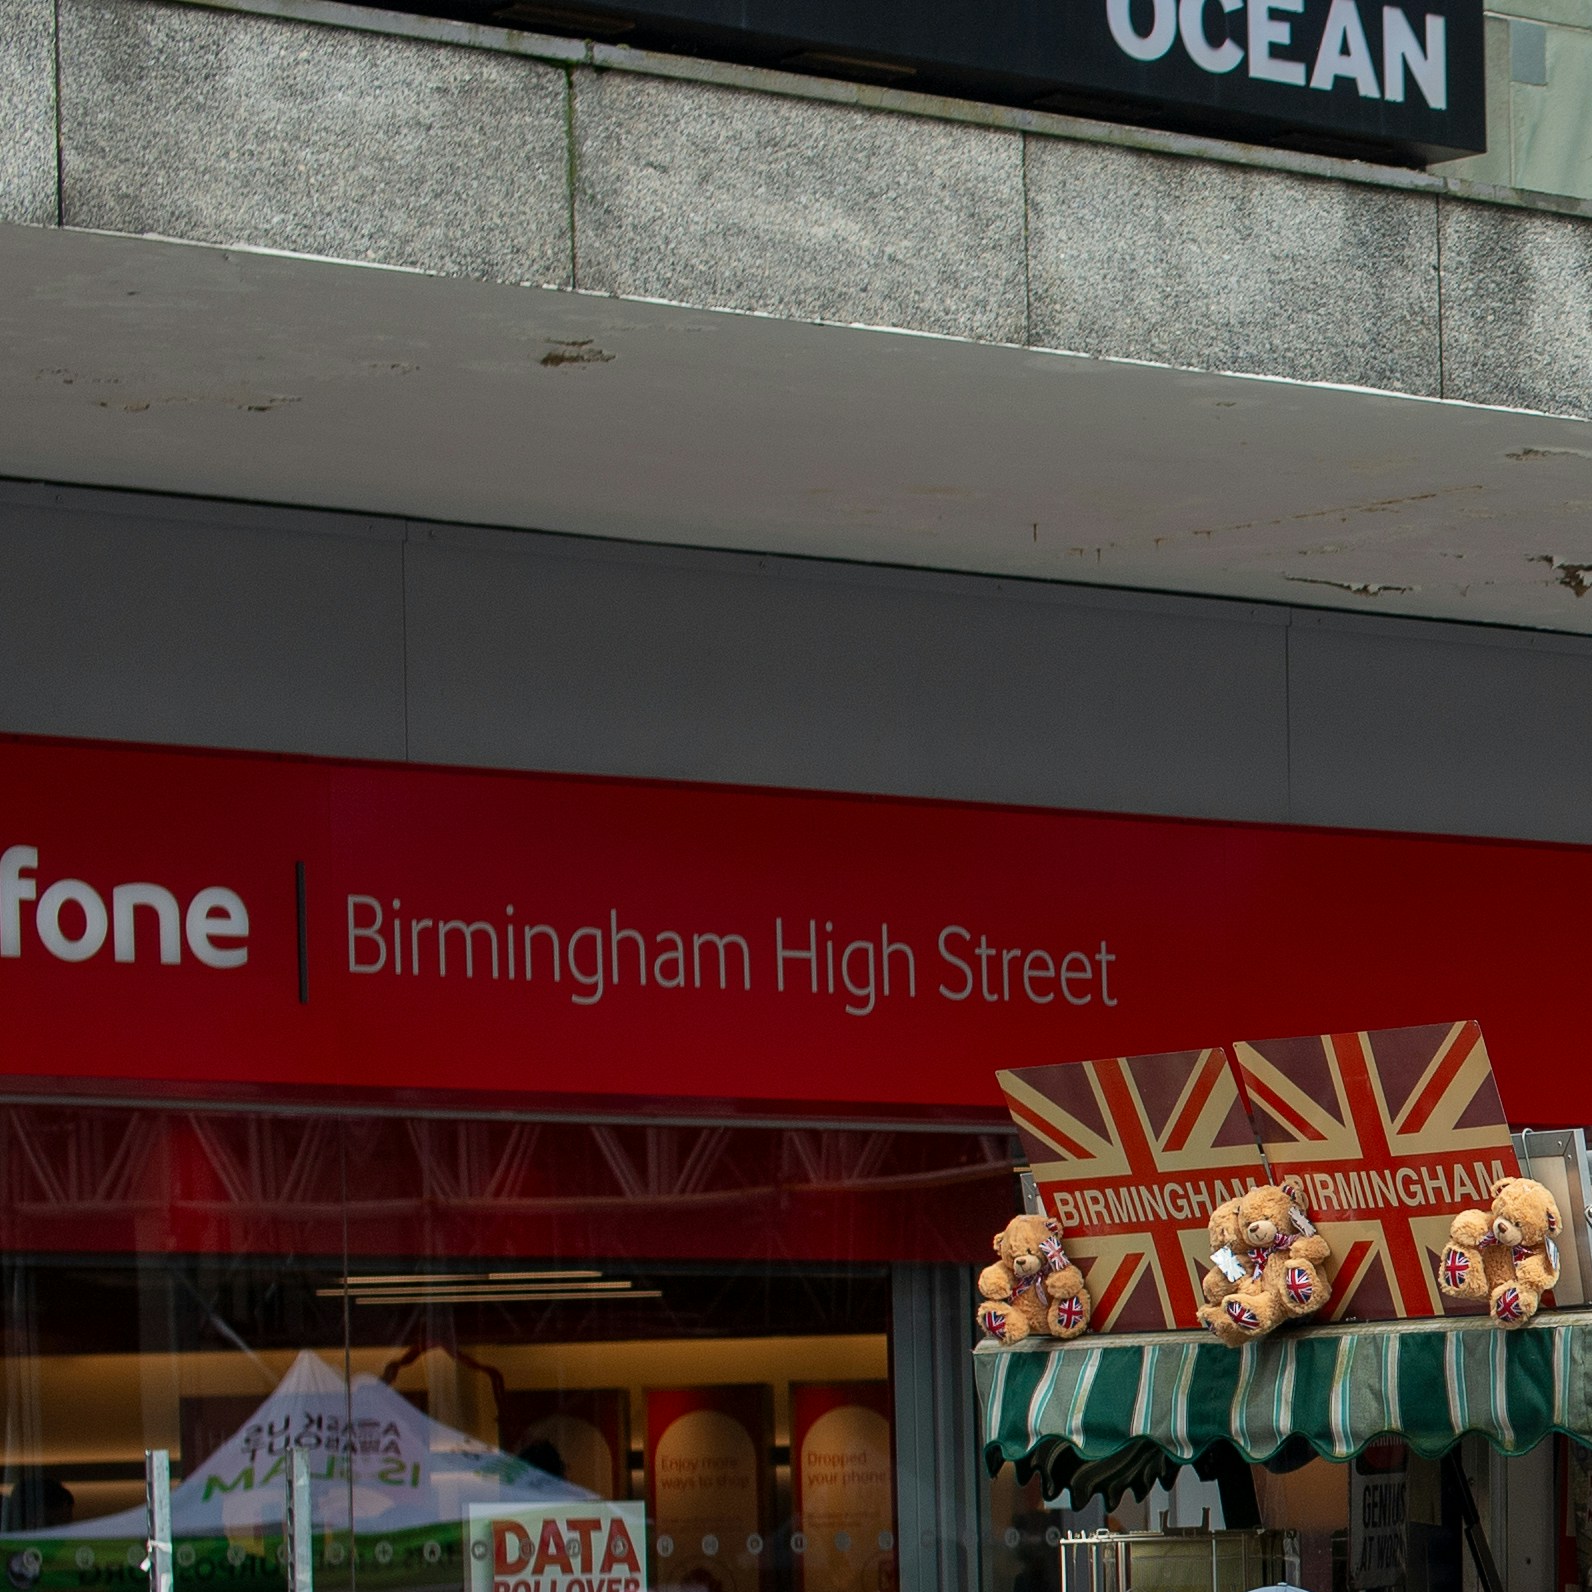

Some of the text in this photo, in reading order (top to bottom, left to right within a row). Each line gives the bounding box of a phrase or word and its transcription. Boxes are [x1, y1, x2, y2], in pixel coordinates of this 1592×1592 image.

[1107, 0, 1447, 110] OCEAN
[345, 895, 1117, 1015] Birmingham High Street
[491, 1517, 641, 1576] DATA
